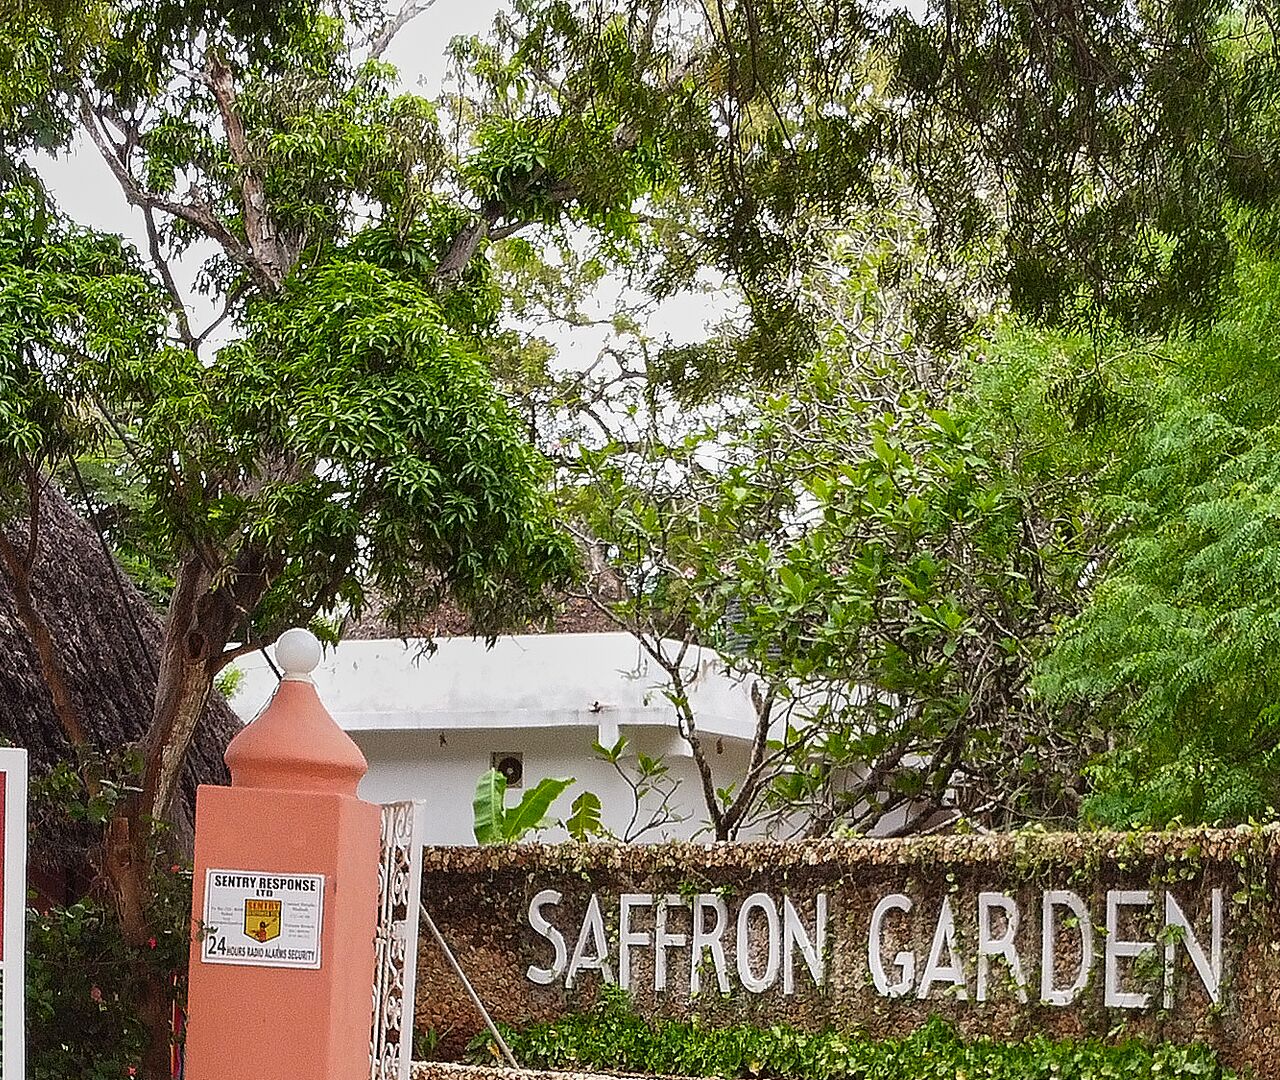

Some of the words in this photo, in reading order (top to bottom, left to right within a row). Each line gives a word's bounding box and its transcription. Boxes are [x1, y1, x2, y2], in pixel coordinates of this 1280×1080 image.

[214, 875, 257, 888] SENTRY
[259, 878, 316, 891] RESPONSE
[256, 889, 274, 898] LTD
[247, 901, 280, 911] SENTRY
[208, 936, 226, 955] 24
[227, 946, 246, 957] HOURS
[247, 946, 264, 958] RADIO
[264, 947, 287, 960] ALARMS
[287, 949, 315, 960] SECURITY
[526, 889, 828, 996] SAFFRON
[868, 887, 1223, 1009] GARDEN
